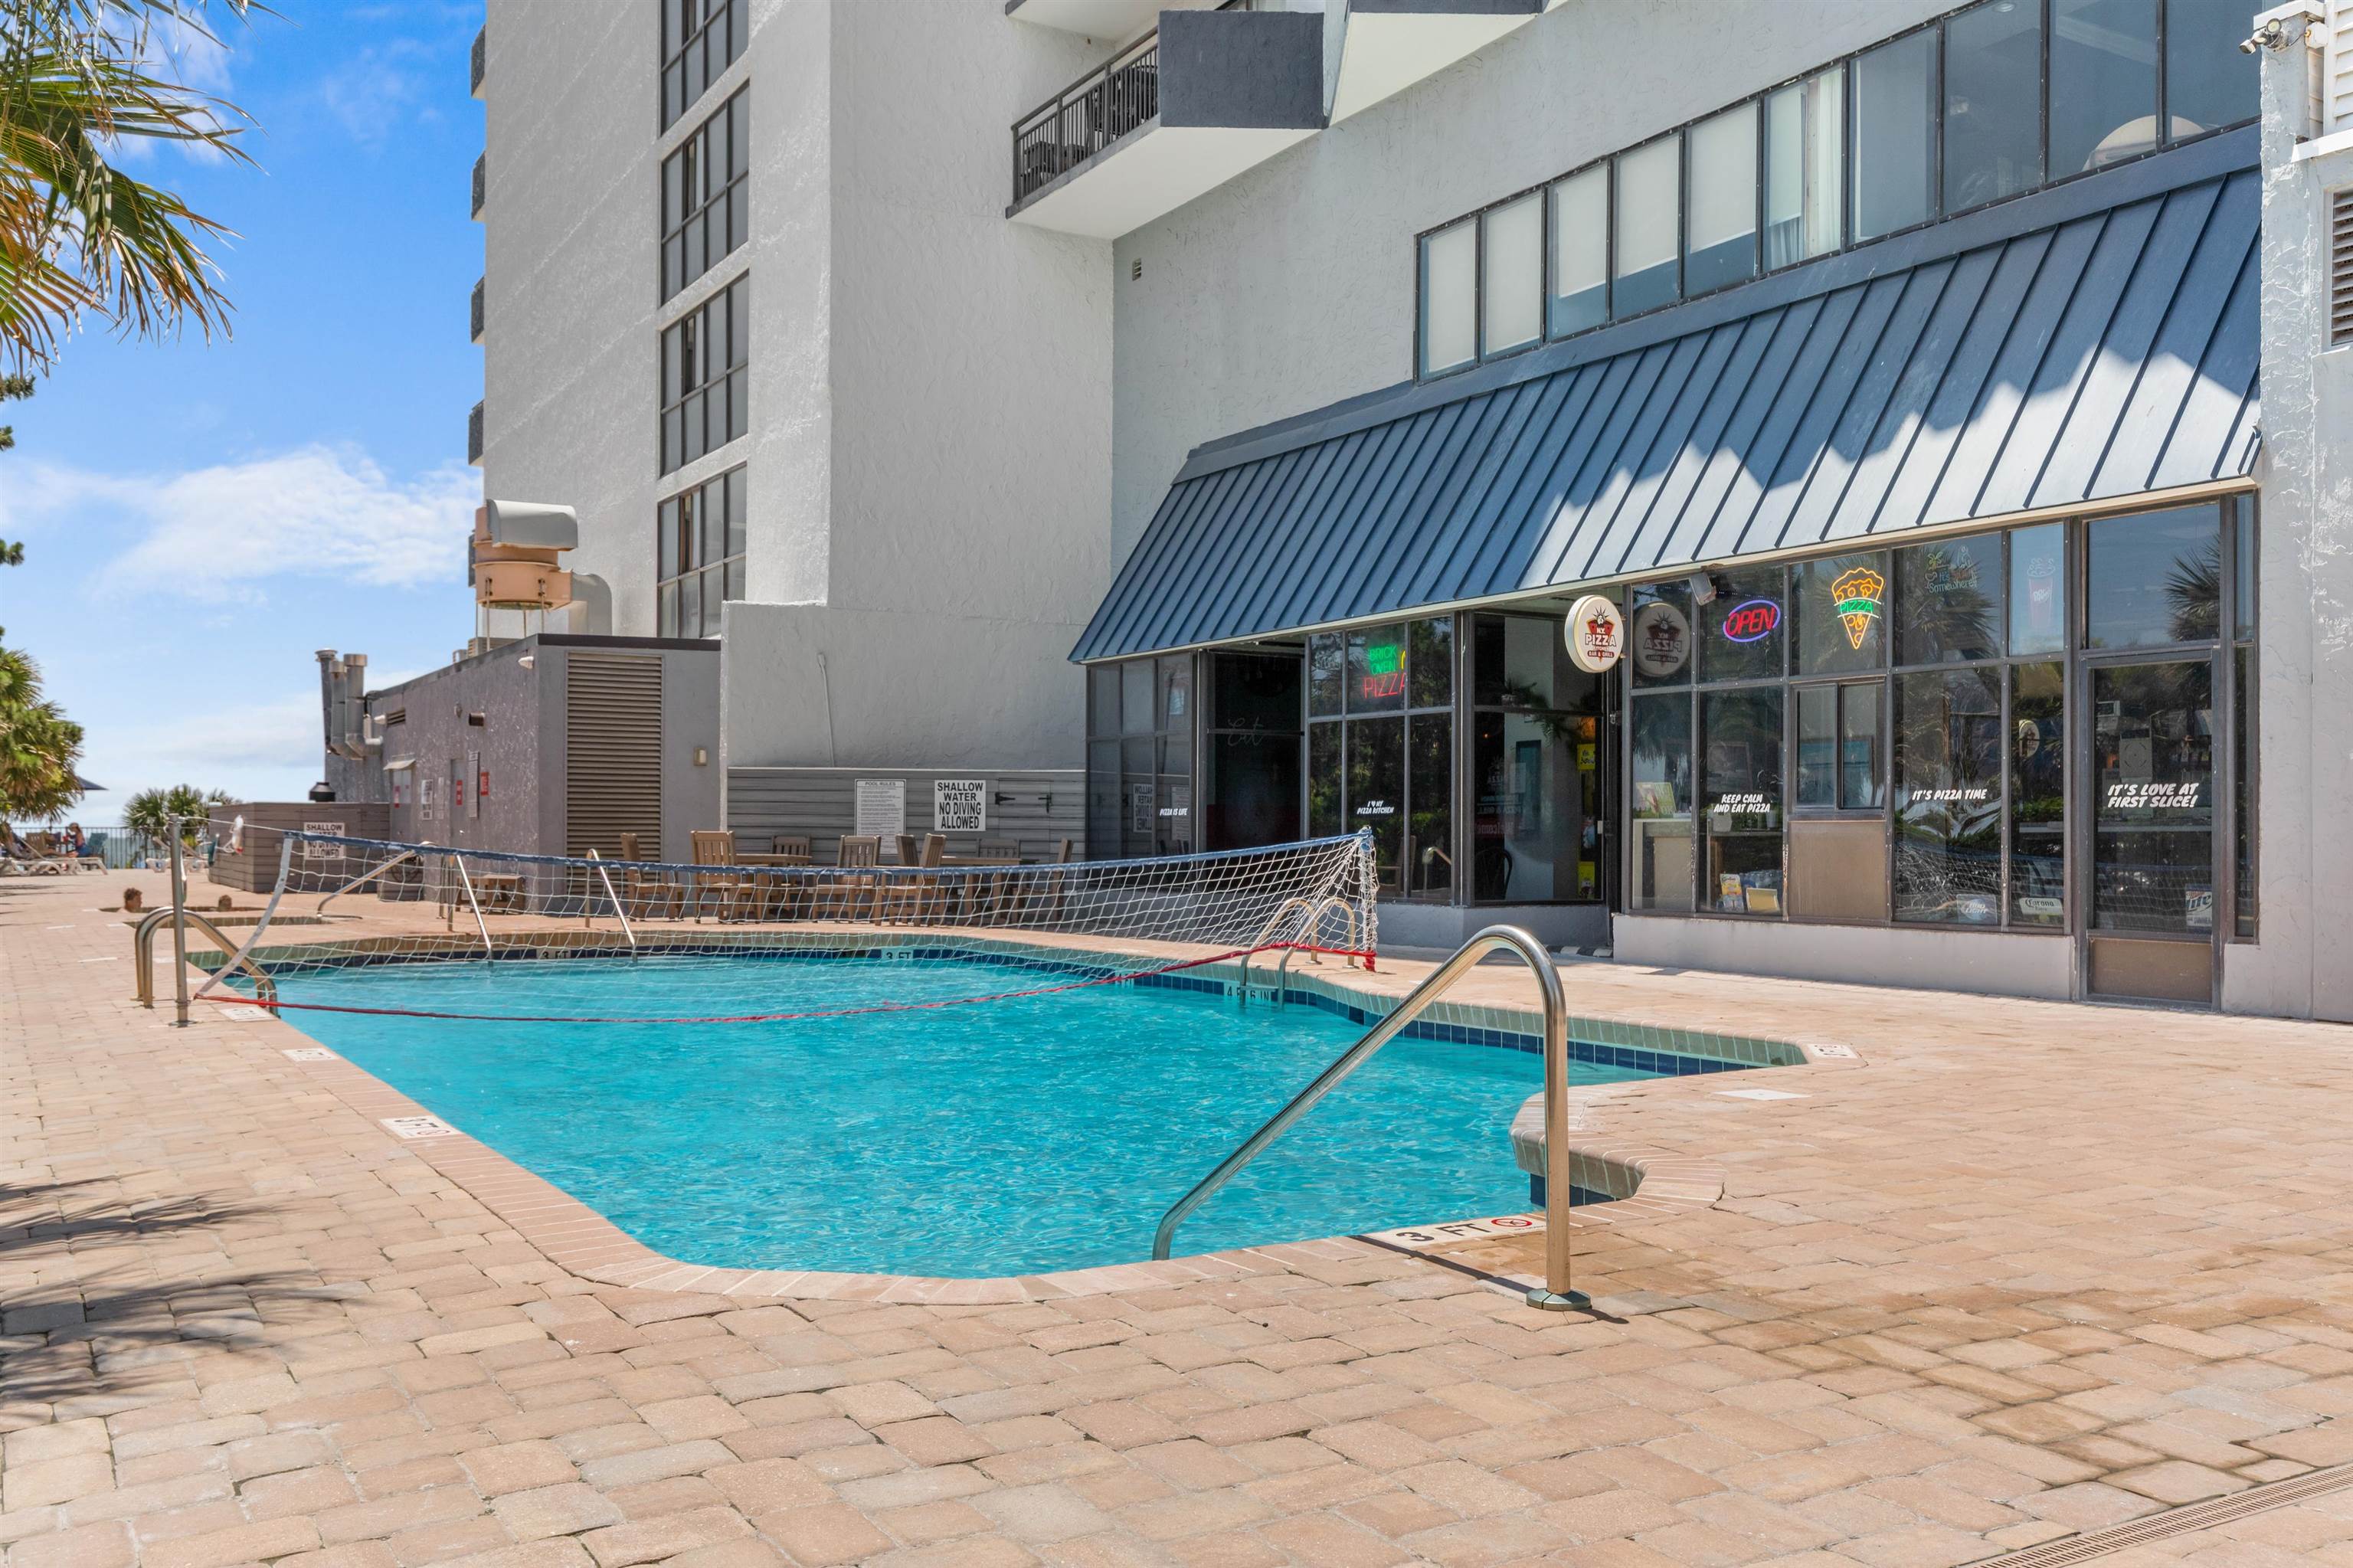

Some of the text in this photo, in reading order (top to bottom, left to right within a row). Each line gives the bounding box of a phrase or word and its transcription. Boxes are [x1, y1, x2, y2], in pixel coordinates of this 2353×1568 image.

[1841, 600, 1874, 613] PIZZA
[1726, 607, 1775, 637] OPEN
[1585, 632, 1616, 647] PIZZA
[1370, 644, 1397, 660] BRICK
[1371, 660, 1396, 674] OVEN
[937, 782, 983, 791] SHALLOW
[2108, 782, 2199, 796] IT'S LOVE AT
[944, 792, 977, 801] WATER
[1721, 794, 1763, 804] KEEP CALM
[1912, 789, 1988, 800] IT'S PIZZA TIME
[2107, 794, 2198, 808] FIRST SLICE!
[939, 803, 981, 815] NO DIVING
[1373, 806, 1394, 814] KITCHEN
[1713, 803, 1770, 813] AND EAT PIZZA
[941, 816, 980, 829] ALLOWED
[2024, 899, 2054, 908] Corona
[1227, 986, 1232, 996] 4
[1250, 990, 1256, 999] 6
[1261, 990, 1269, 1000] IN
[1396, 1223, 1491, 1242] 3 FT
